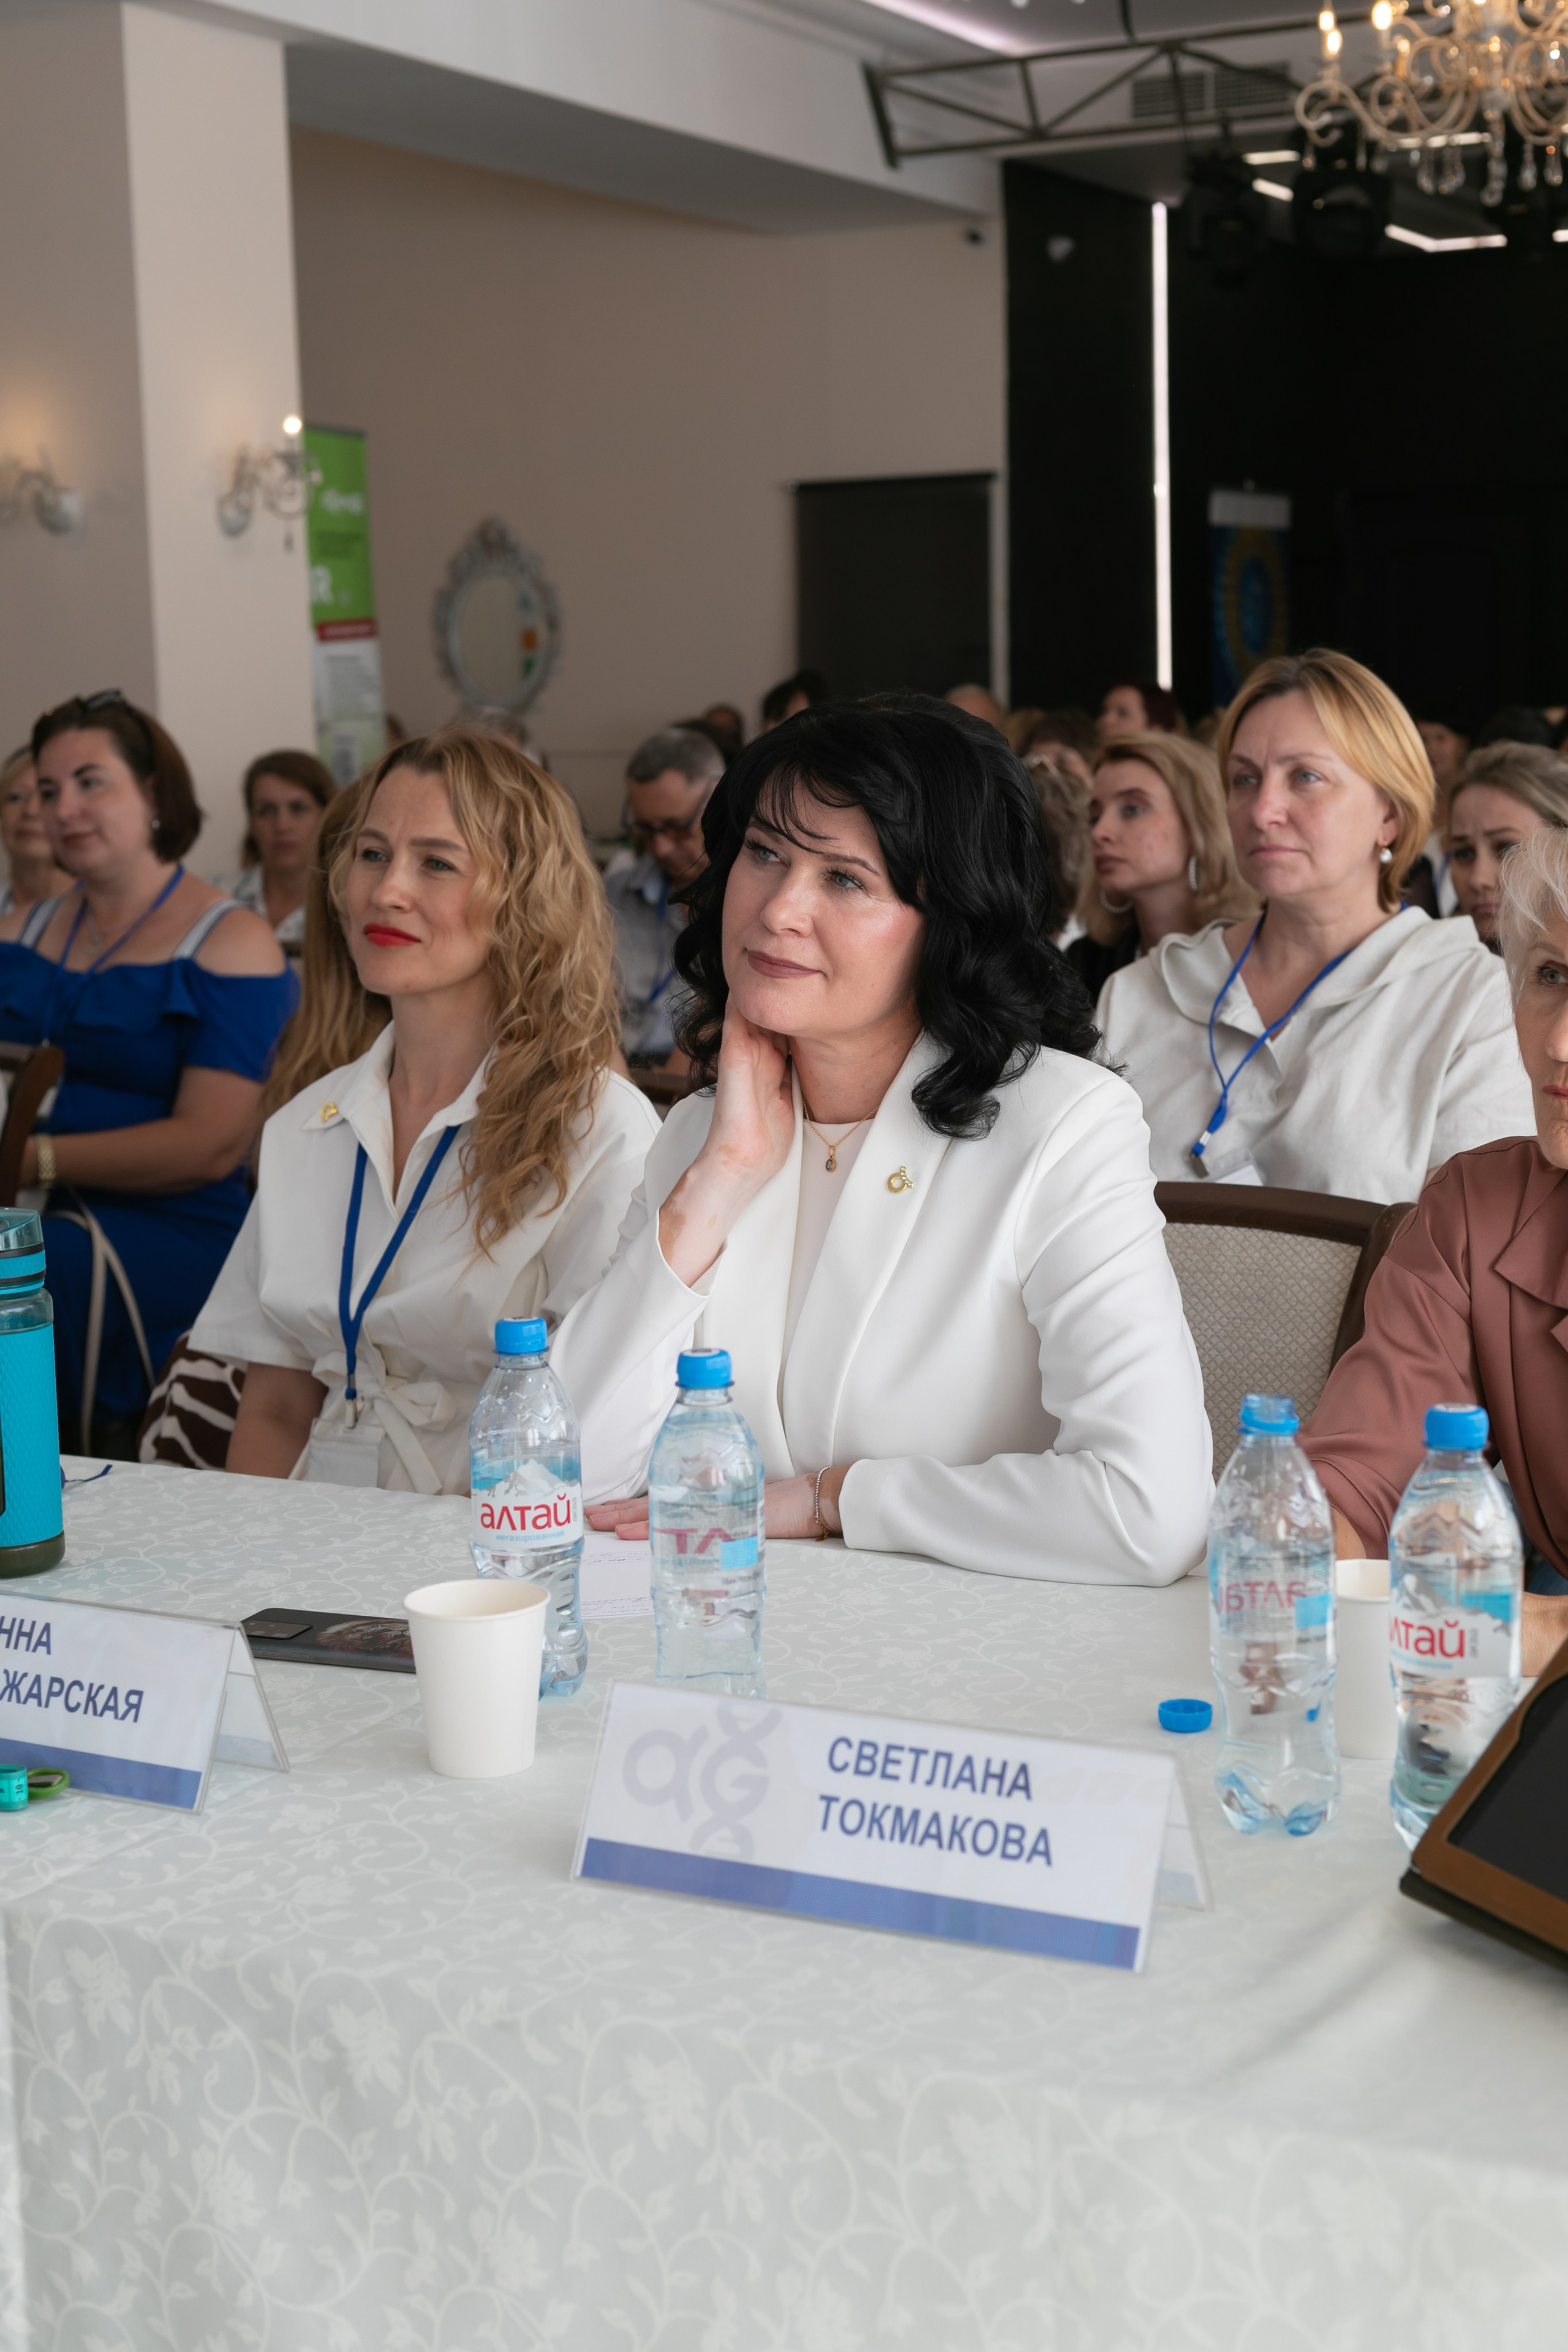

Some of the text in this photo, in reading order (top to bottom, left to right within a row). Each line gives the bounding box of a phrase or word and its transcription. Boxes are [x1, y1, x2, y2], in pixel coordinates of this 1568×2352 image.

[480, 1493, 571, 1531] алтай
[496, 1530, 564, 1542] негазированная
[828, 1736, 1032, 1801] СВЕТЛАНА
[15, 1784, 23, 1793] 10
[820, 1794, 1052, 1867] ТОКМАКОВА
